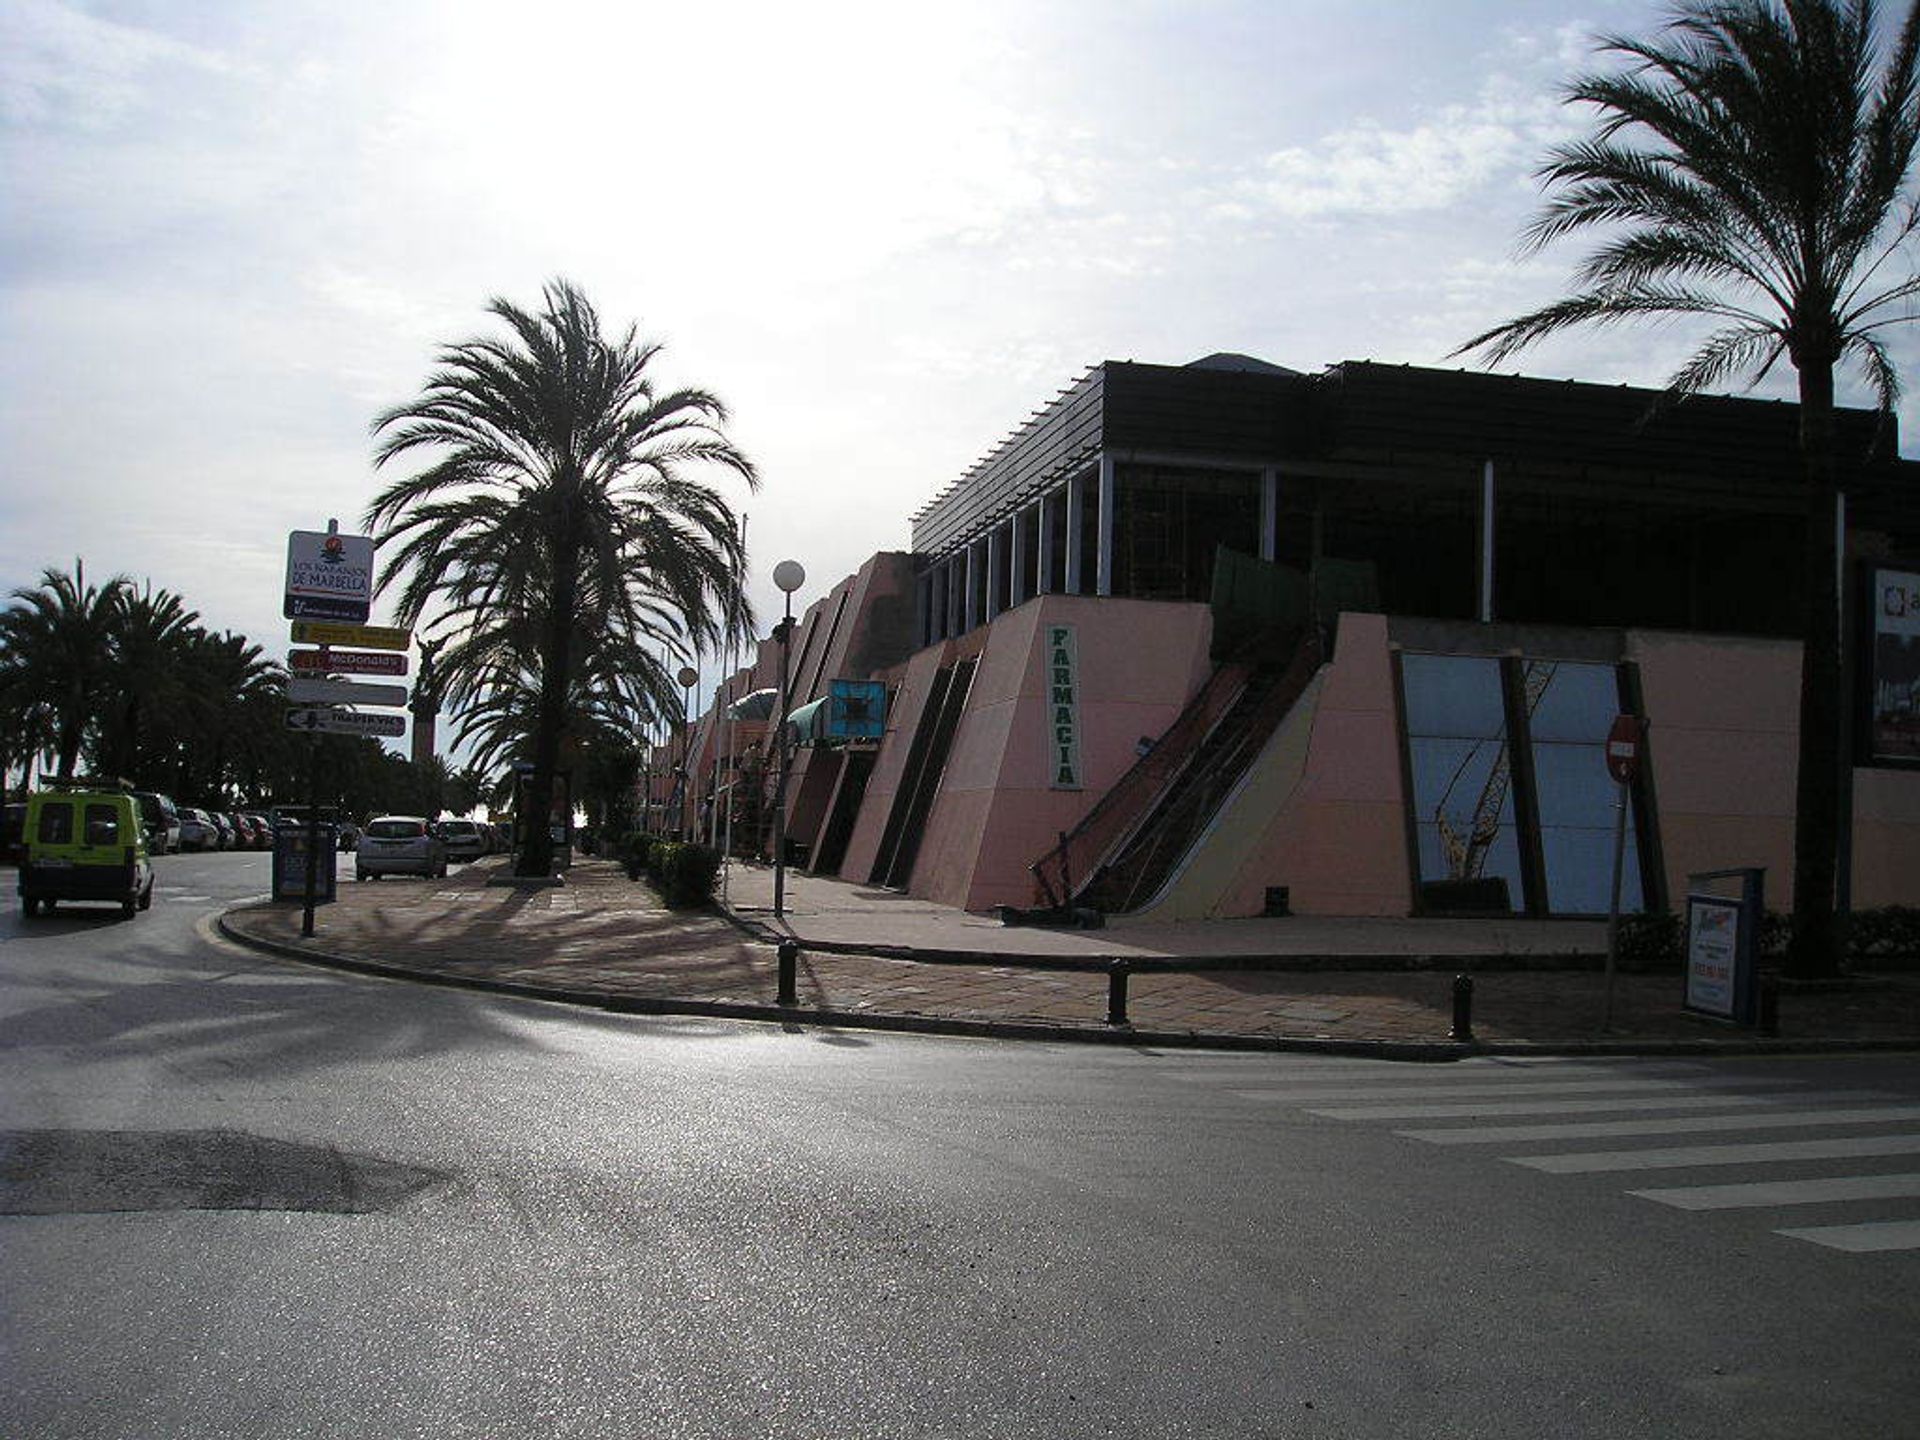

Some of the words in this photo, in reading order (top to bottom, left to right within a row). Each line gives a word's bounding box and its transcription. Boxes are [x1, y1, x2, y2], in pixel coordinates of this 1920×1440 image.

[294, 561, 313, 573] LOS
[292, 571, 308, 586] DE
[309, 573, 366, 591] MARBELLA
[329, 653, 398, 667] McDonald's
[1053, 628, 1074, 784] FARMACIA
